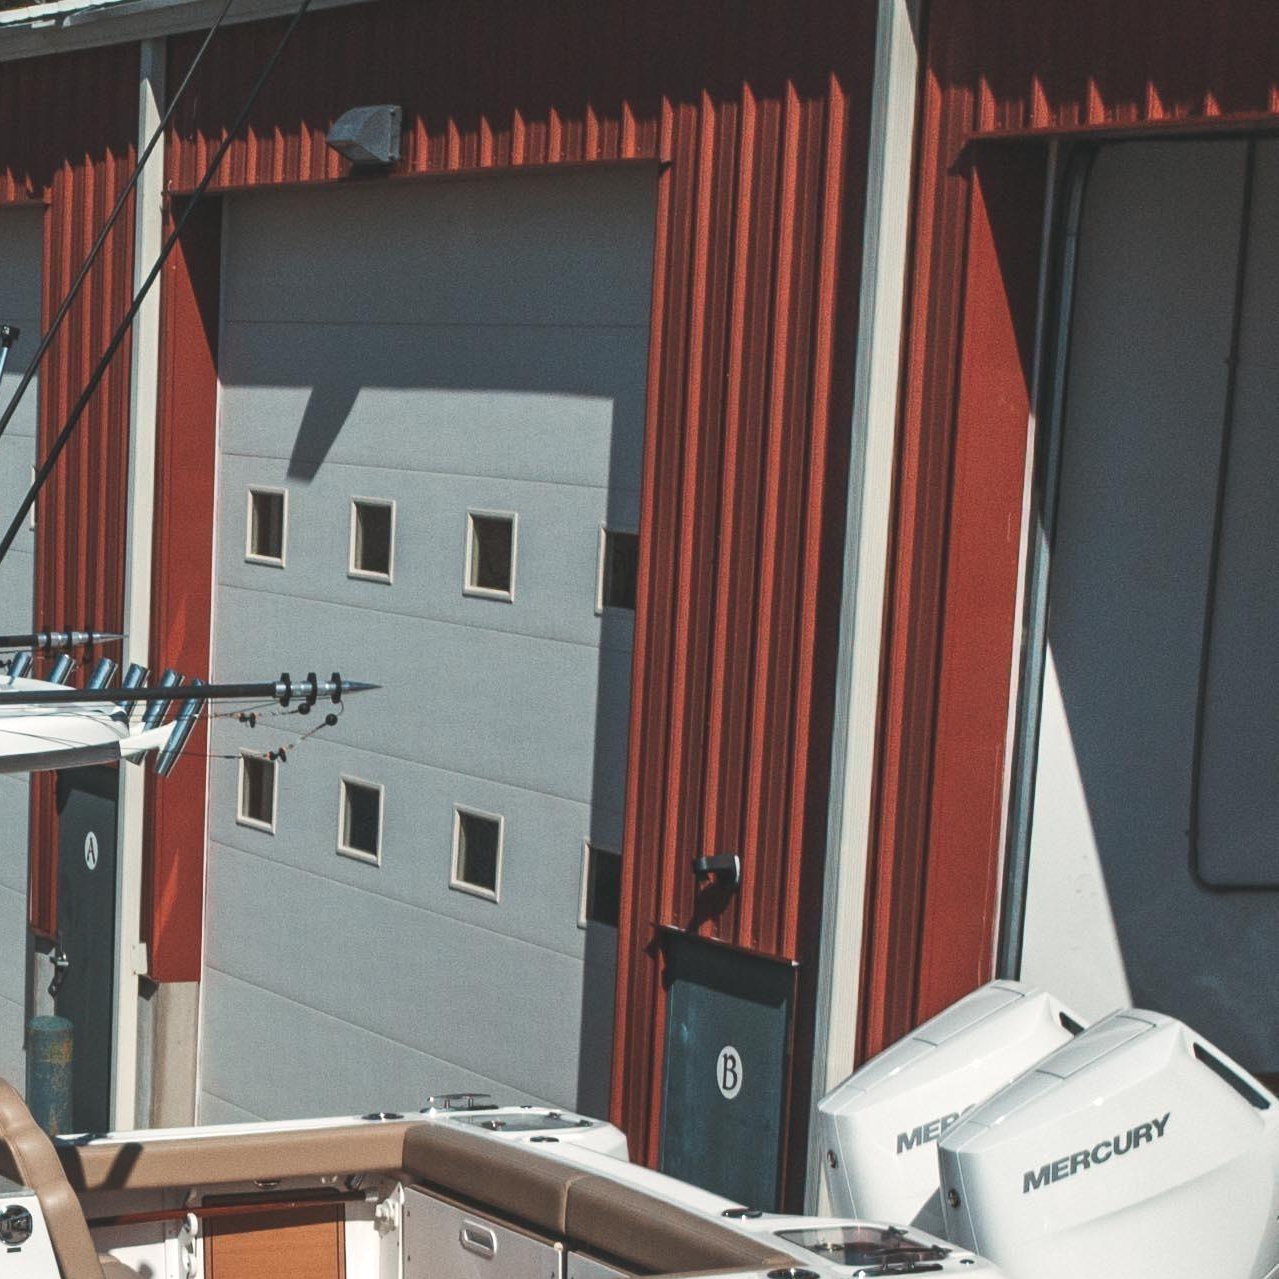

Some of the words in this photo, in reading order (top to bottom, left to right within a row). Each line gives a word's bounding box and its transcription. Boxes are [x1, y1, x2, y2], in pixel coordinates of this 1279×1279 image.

[87, 837, 96, 865] A
[722, 1053, 738, 1090] B
[1023, 1111, 1171, 1194] MERCURY
